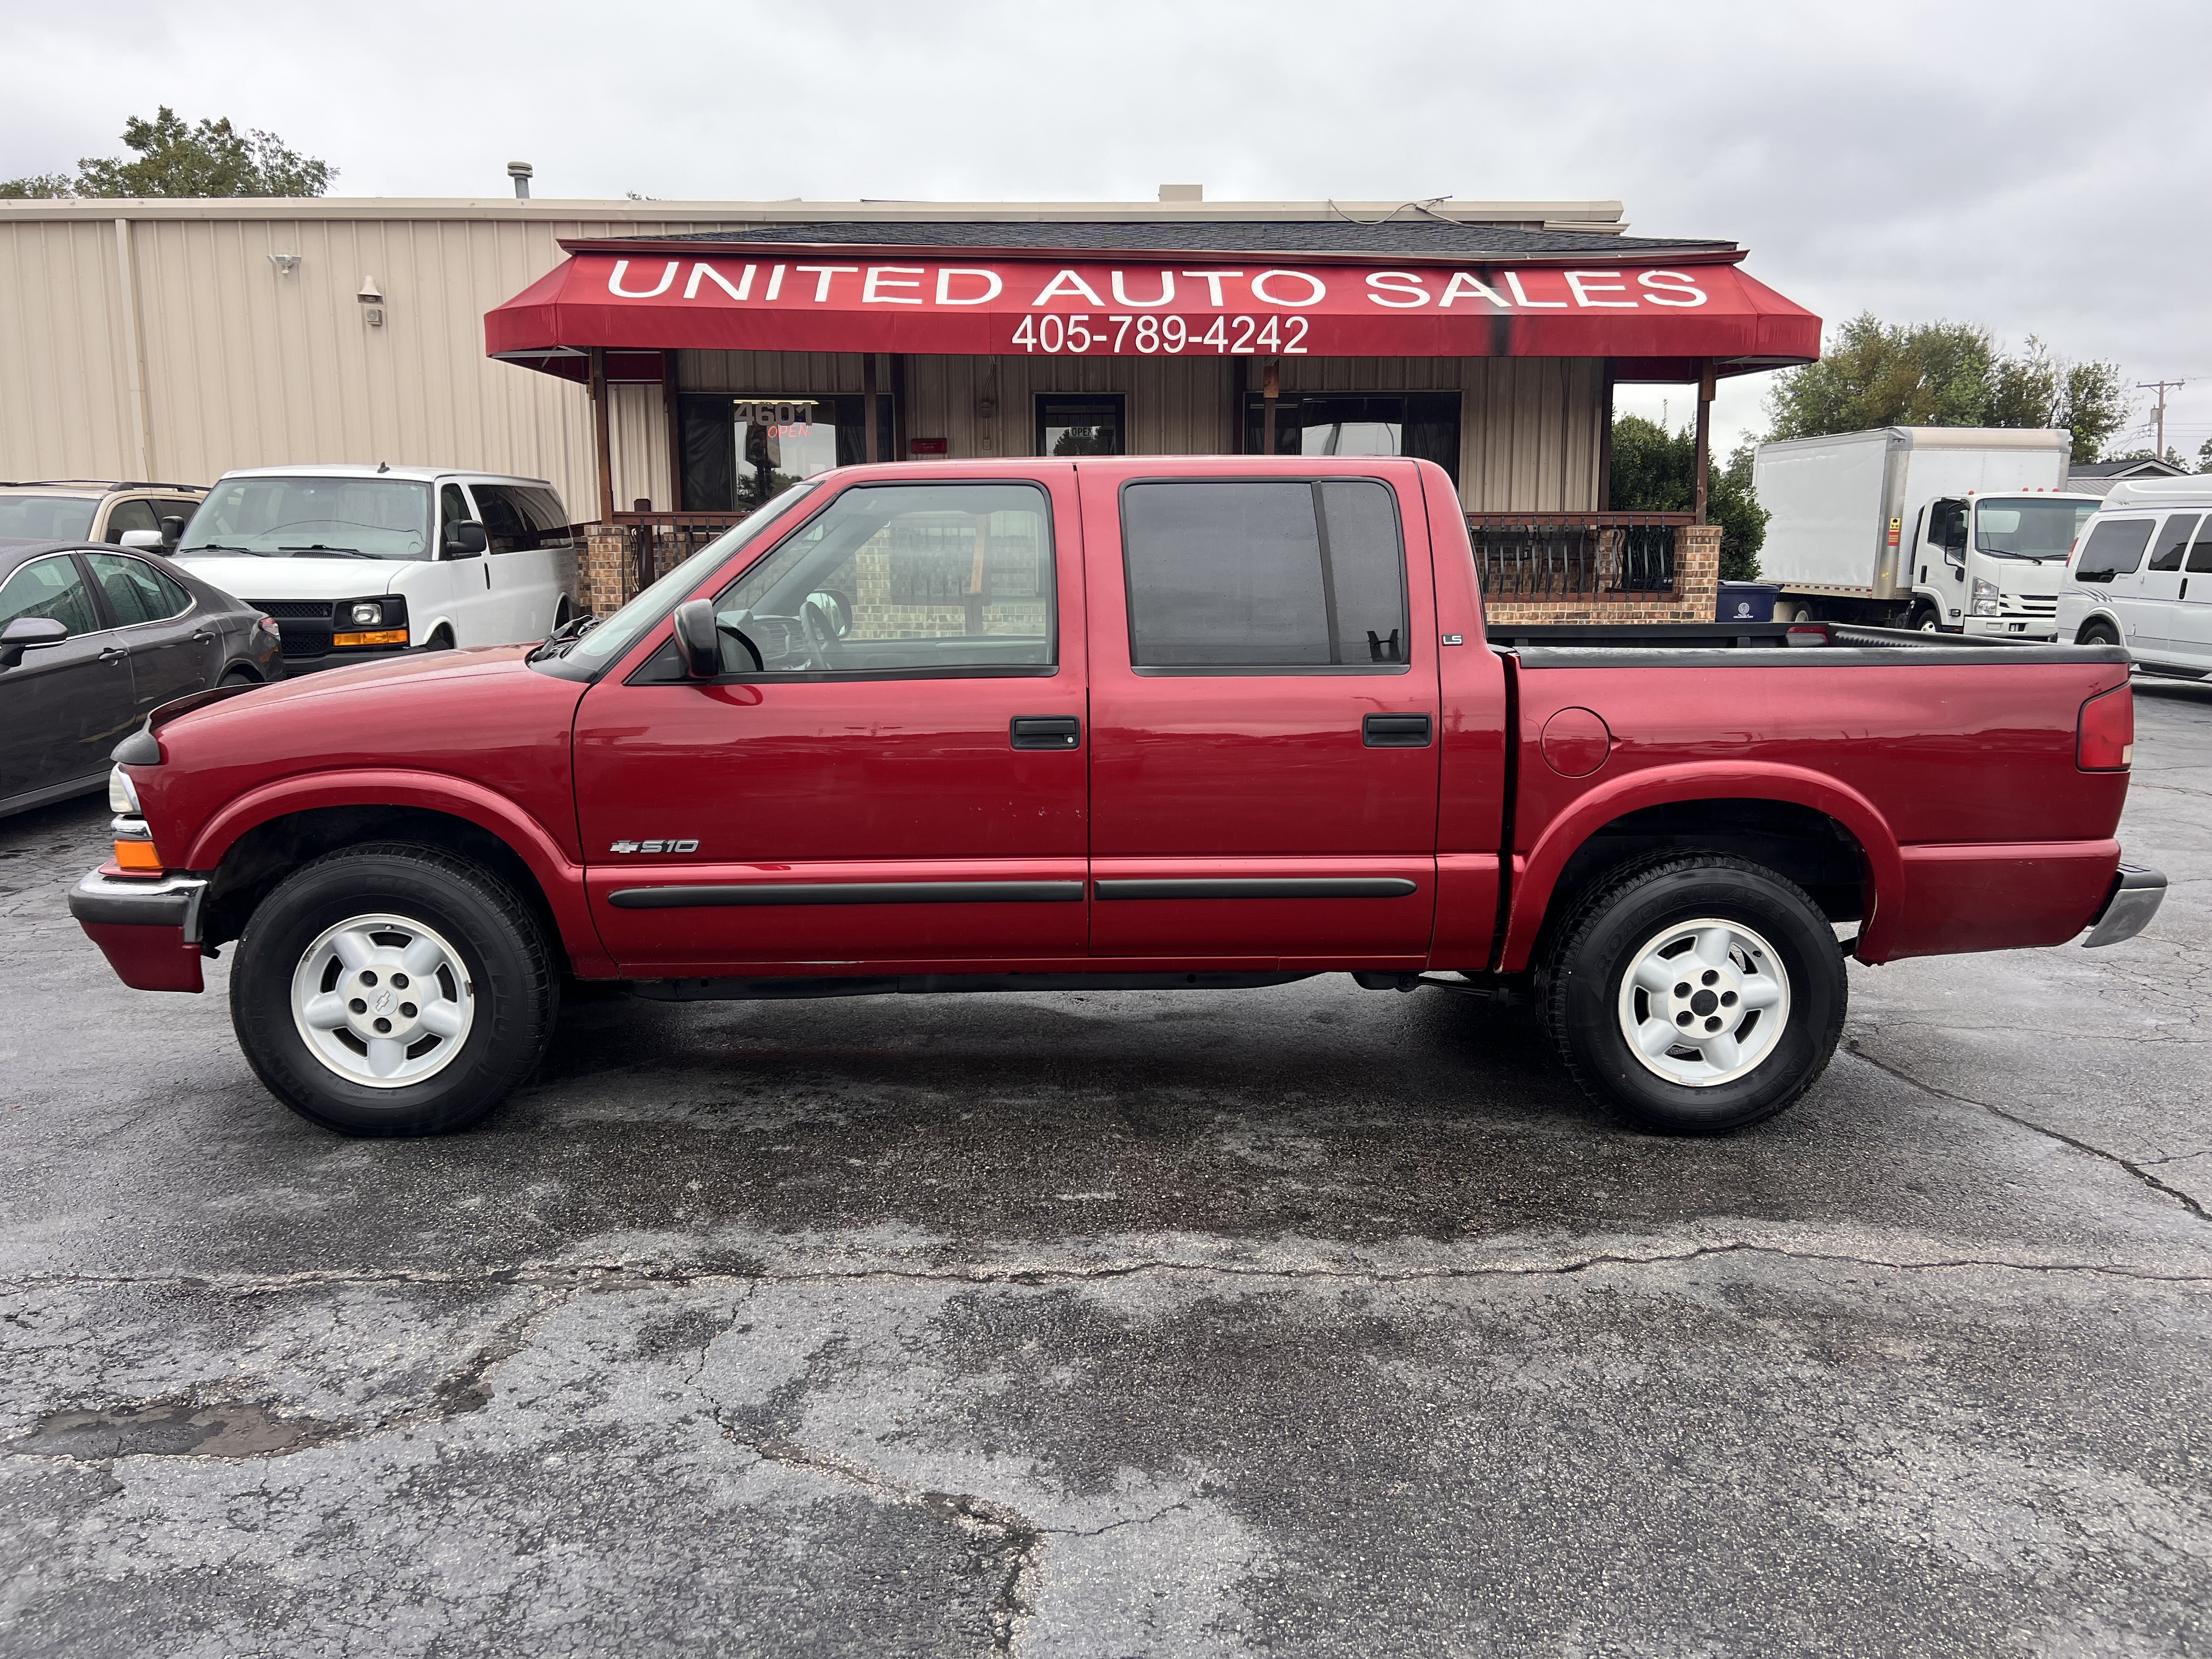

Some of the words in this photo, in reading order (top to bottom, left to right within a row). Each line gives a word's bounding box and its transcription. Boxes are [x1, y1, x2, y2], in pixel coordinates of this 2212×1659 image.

[607, 260, 1003, 305] UNITED
[1031, 269, 1326, 307] AUTO
[1364, 270, 1707, 308] SALES
[1011, 314, 1309, 354] 405-789-4242
[734, 402, 812, 426] 4601
[768, 425, 809, 438] OPEN
[1443, 635, 1462, 644] LS
[640, 839, 699, 853] S10
[1593, 885, 1711, 979] ROADIAN
[1724, 888, 1765, 907] AT
[1661, 1057, 1807, 1121] NEXEN
